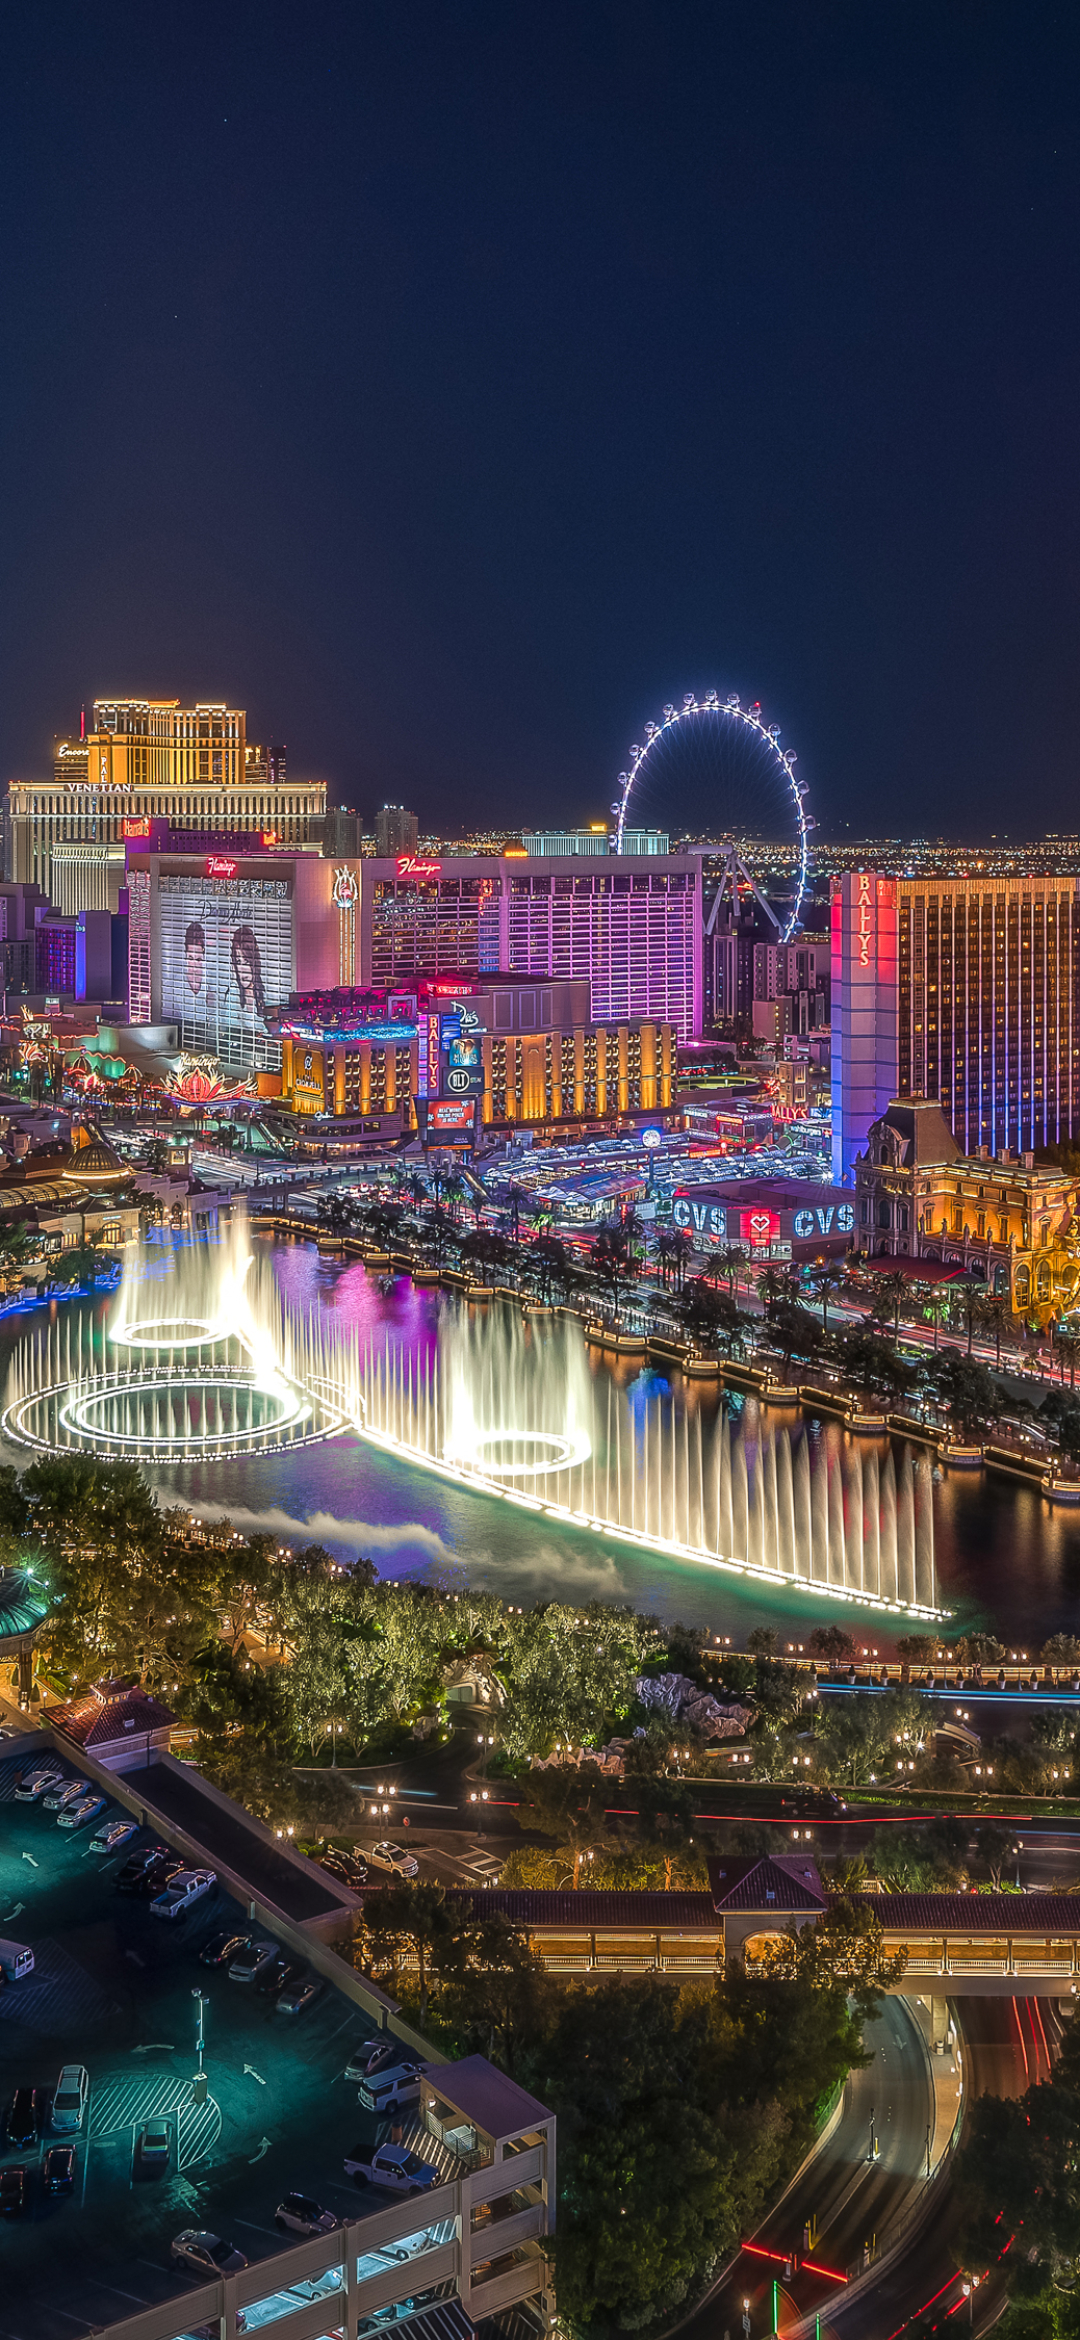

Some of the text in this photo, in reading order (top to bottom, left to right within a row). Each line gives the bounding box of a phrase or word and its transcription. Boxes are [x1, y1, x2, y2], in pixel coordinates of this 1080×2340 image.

[59, 744, 90, 757] Encore
[68, 783, 132, 792] VENETIAN
[208, 857, 236, 876] Flamingo
[397, 857, 441, 876] Flamingo
[857, 875, 872, 966] BALLYS
[180, 1052, 221, 1069] Flamingo
[428, 1017, 439, 1087] BALLYS
[453, 1074, 466, 1087] BLT
[673, 1200, 725, 1236] CVS
[794, 1204, 855, 1238] CVS
